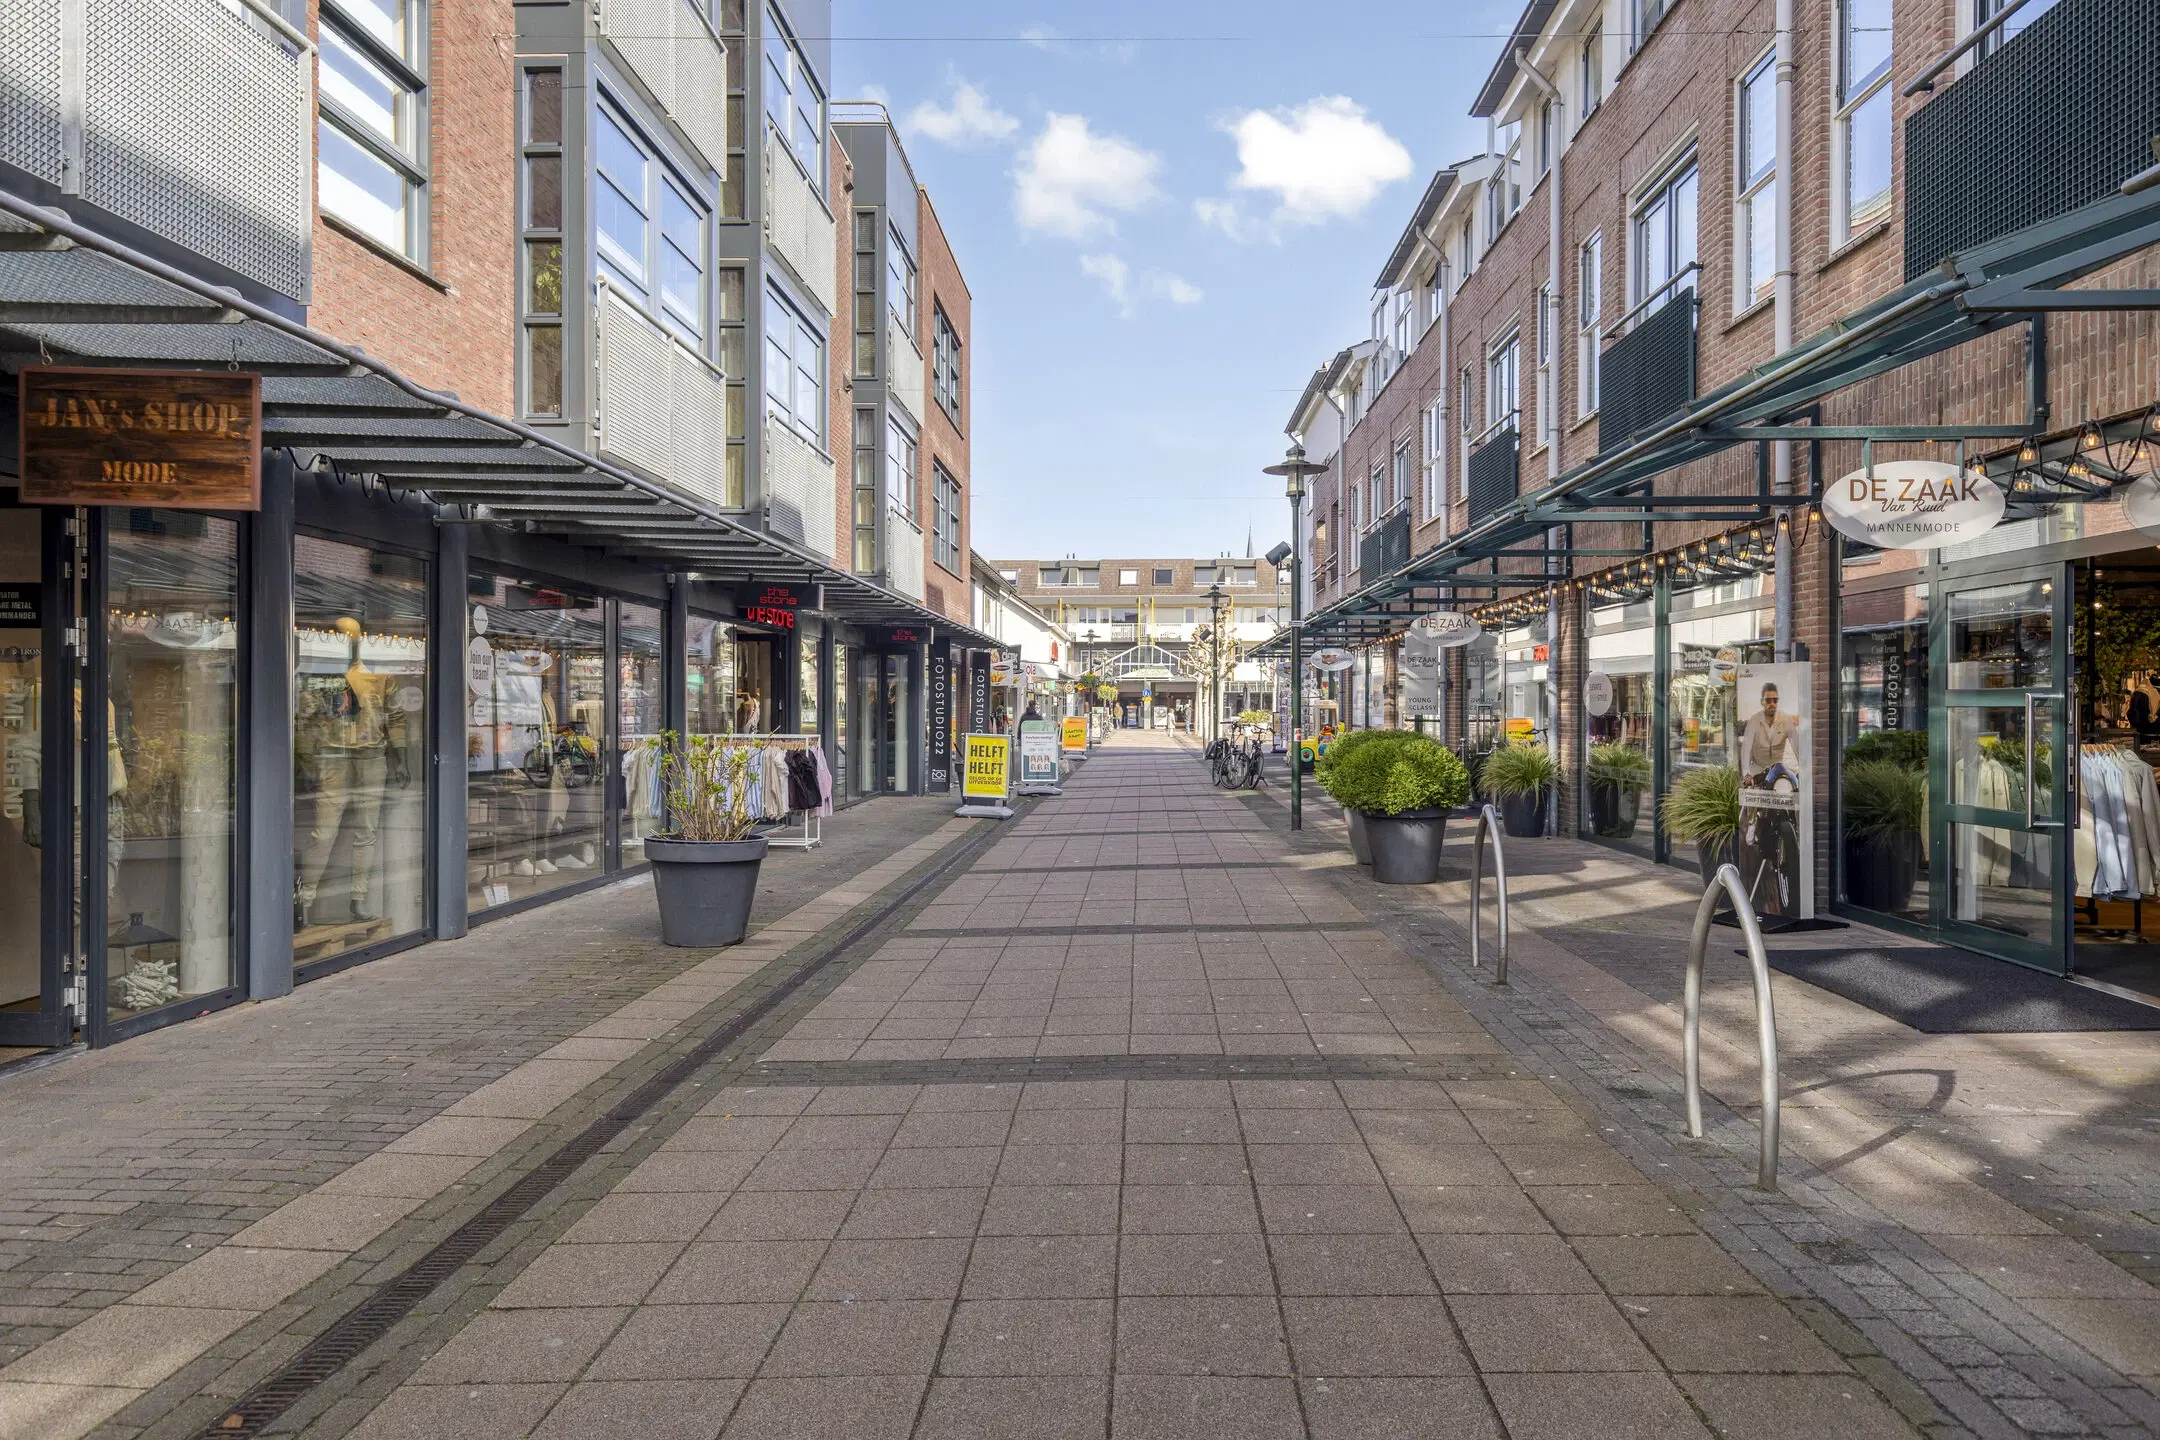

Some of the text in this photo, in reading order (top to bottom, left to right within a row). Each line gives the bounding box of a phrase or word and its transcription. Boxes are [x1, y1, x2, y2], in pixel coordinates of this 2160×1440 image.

[144, 401, 239, 433] SHOP
[101, 461, 177, 483] MODE
[1849, 478, 1980, 502] DE ZAAK
[1881, 498, 1949, 512] Van Ruud
[1866, 523, 1960, 533] MANNENMODE
[1420, 618, 1472, 628] DE ZAAK
[934, 657, 945, 755] FOTOSTUDIO22
[970, 744, 1004, 758] HELFT
[969, 762, 1003, 775] HELFT
